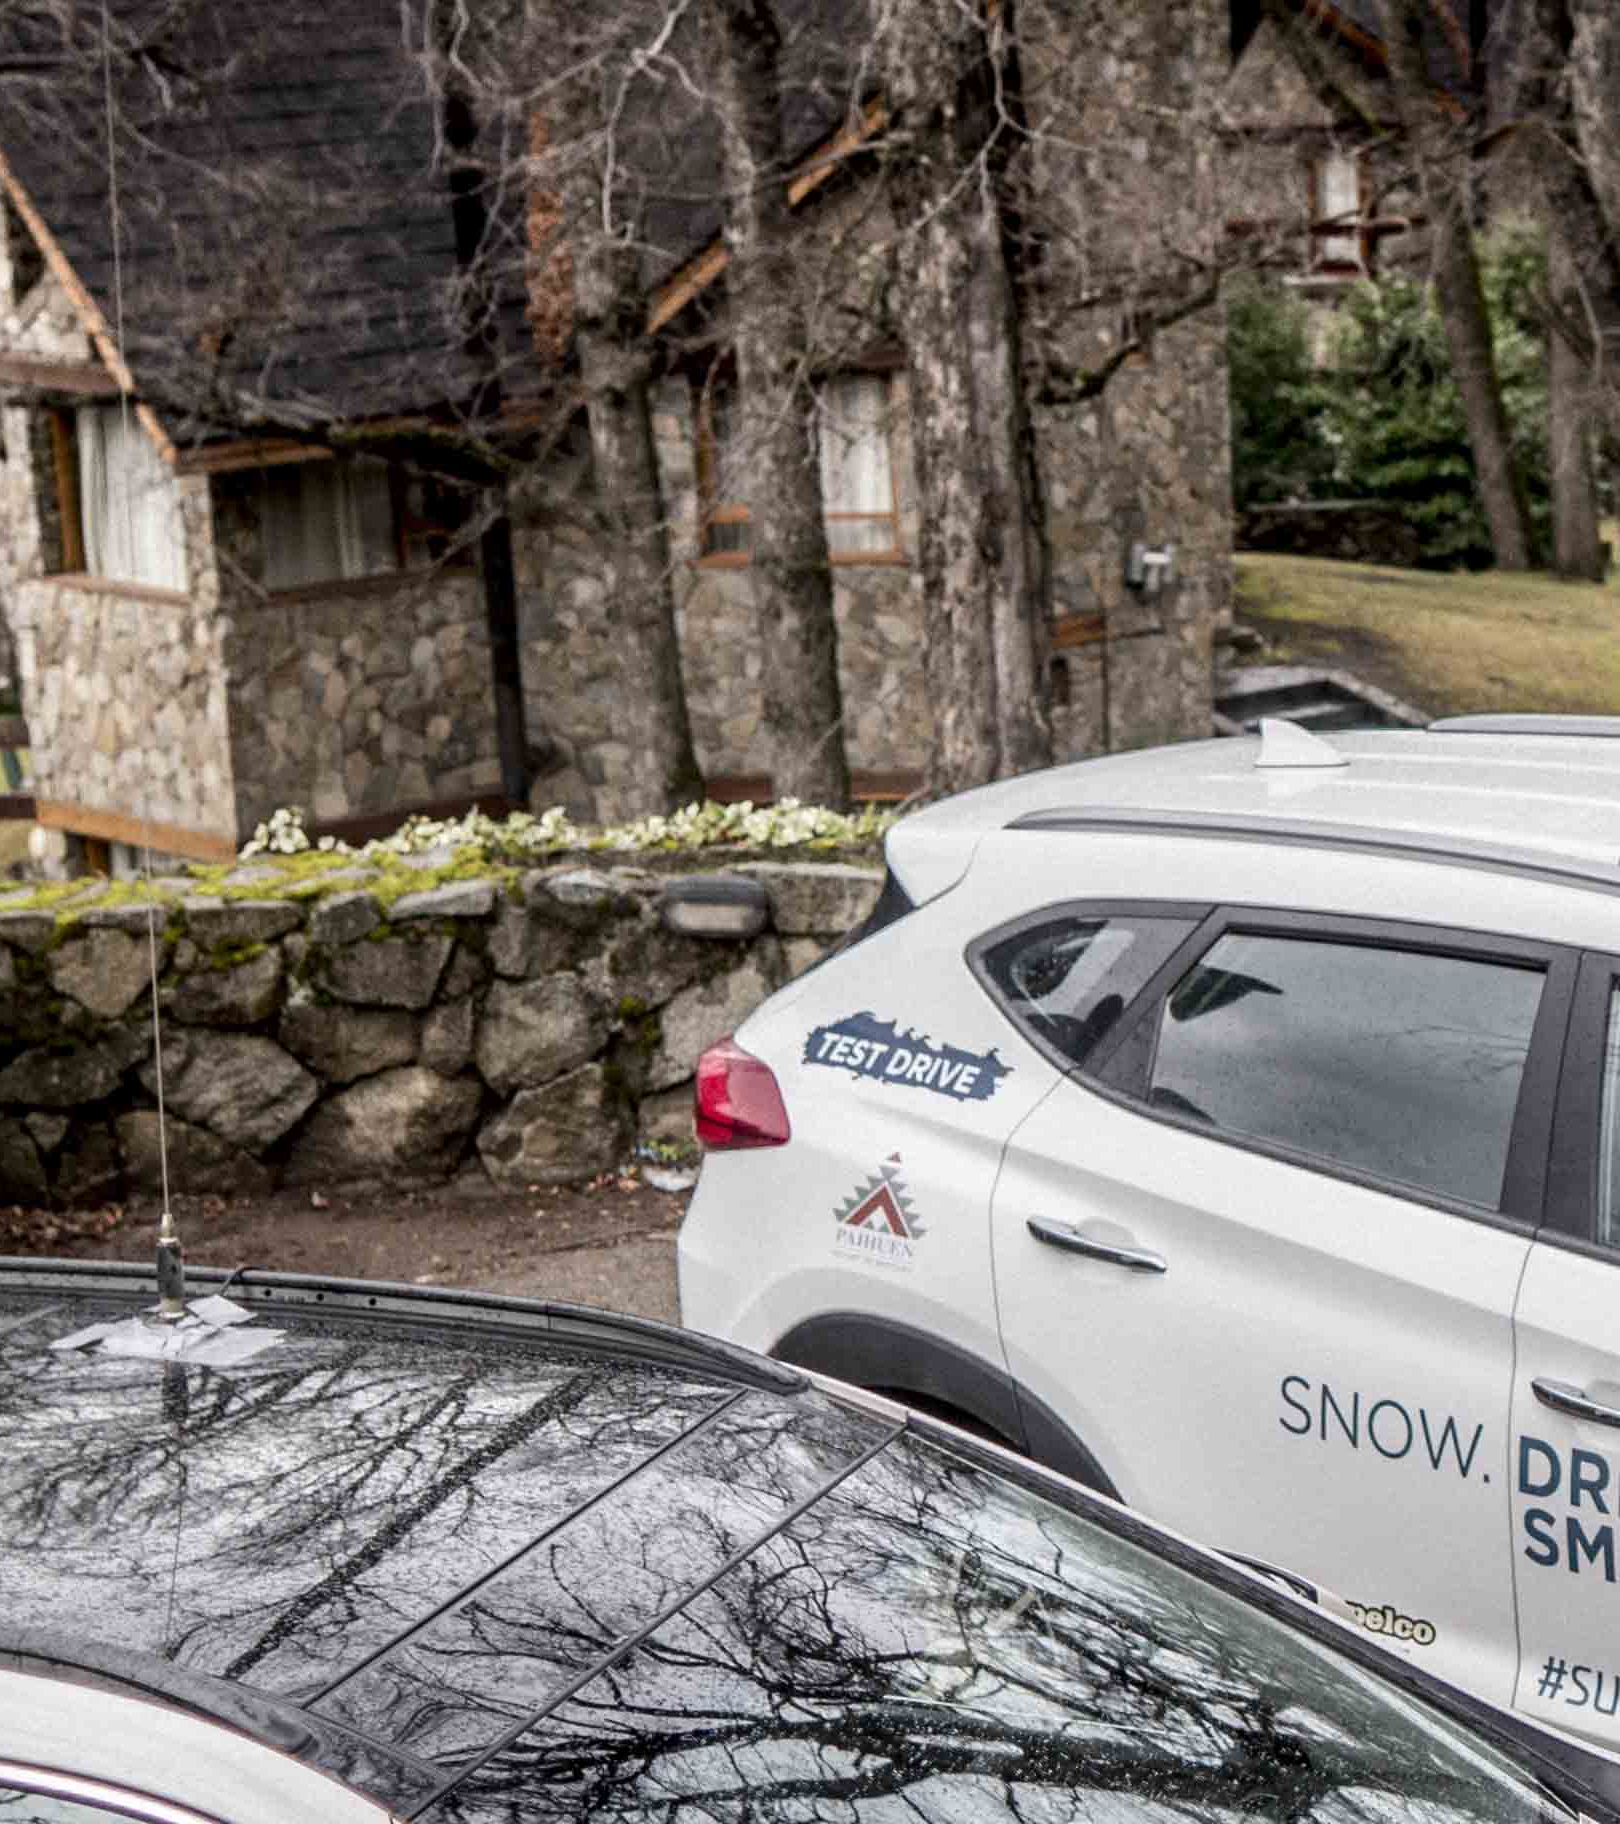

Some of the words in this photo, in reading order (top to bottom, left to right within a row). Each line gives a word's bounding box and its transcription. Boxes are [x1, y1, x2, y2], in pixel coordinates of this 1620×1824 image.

[817, 1031, 889, 1070] TEST
[885, 1047, 981, 1094] DRIVE
[1280, 1376, 1490, 1483] SNOW.
